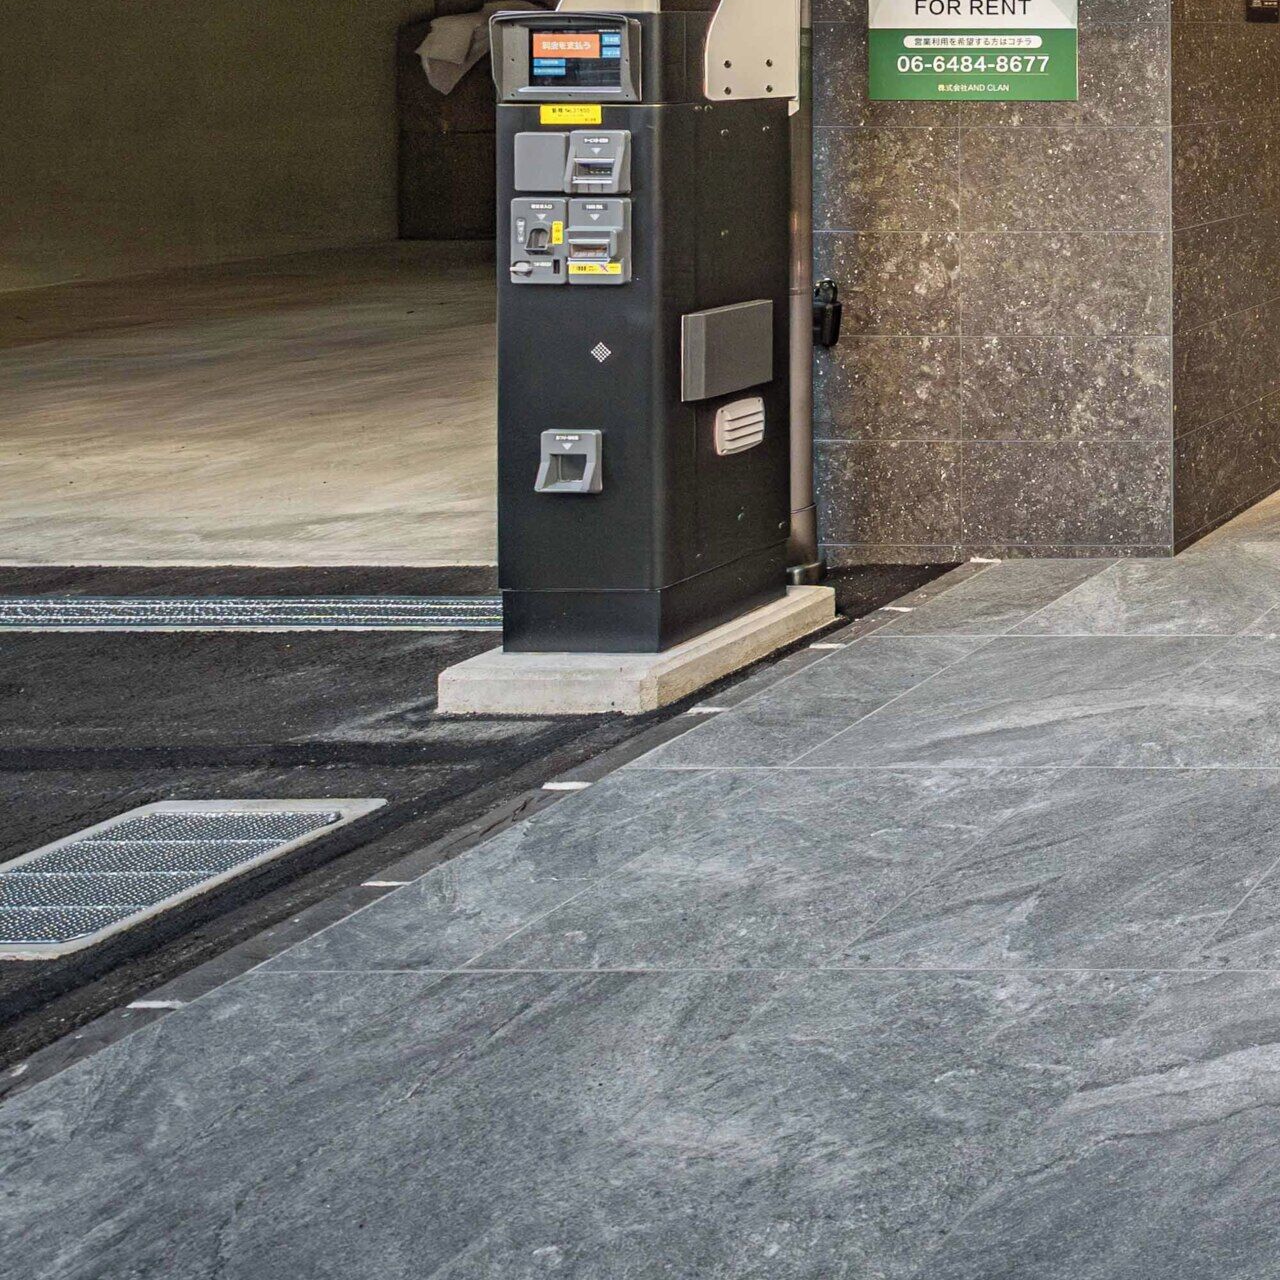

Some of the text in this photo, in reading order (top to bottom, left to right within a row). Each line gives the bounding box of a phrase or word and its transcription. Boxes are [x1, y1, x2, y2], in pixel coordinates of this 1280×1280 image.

[915, 0, 1032, 15] FOR RENT
[914, 37, 1032, 46] 営業利用を希望する方はコチラ
[897, 56, 1049, 72] 06-6484-8677
